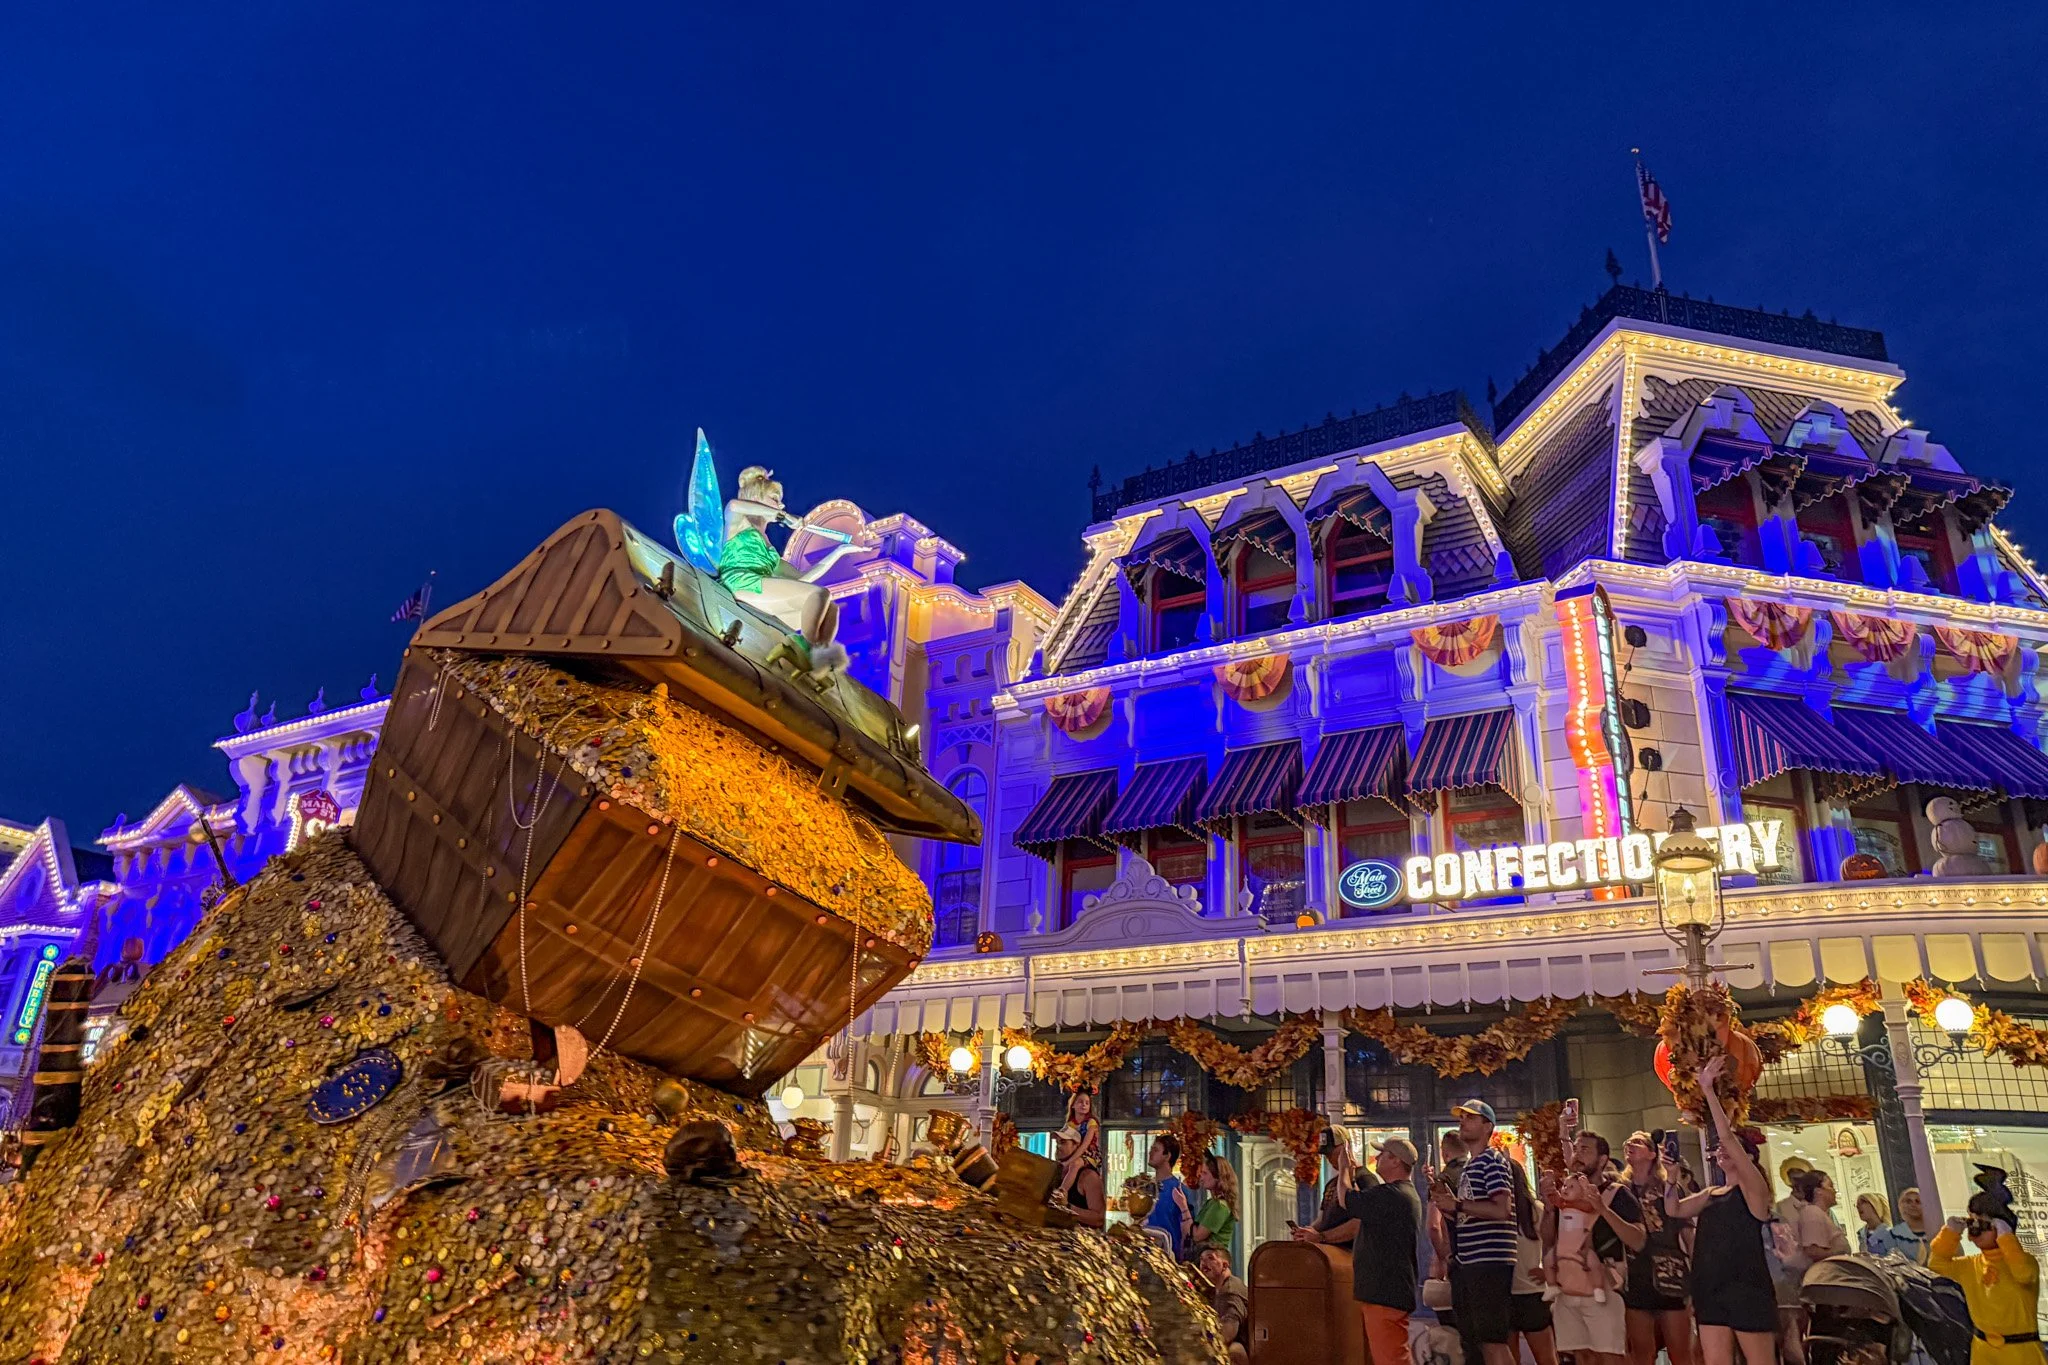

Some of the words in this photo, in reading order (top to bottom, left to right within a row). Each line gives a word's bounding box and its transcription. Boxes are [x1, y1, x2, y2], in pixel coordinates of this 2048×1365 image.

[301, 800, 335, 812] MAIN
[1406, 820, 1783, 899] CONFECTIORY
[1347, 867, 1388, 887] Main
[1354, 882, 1387, 898] Street
